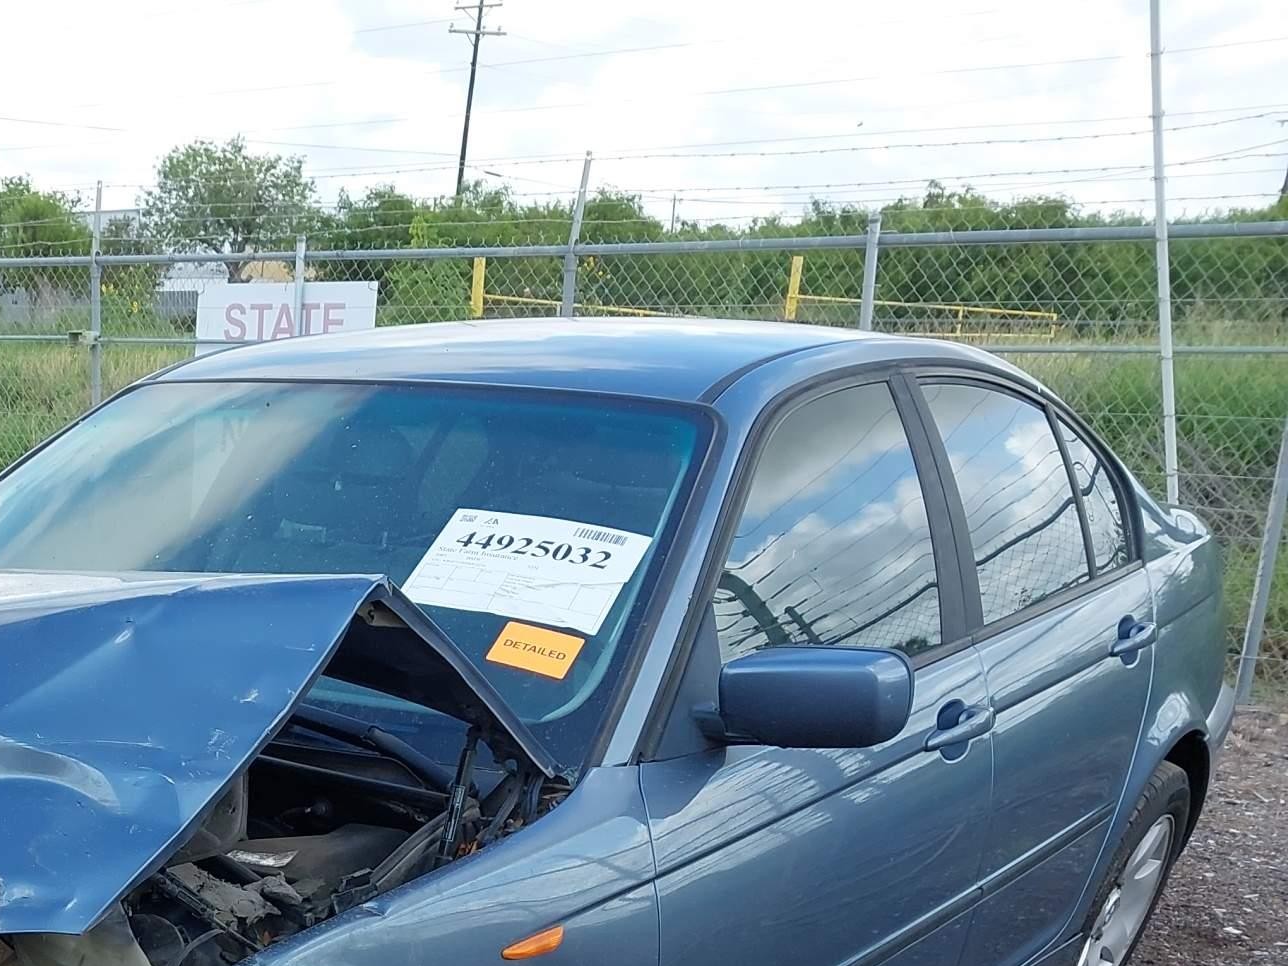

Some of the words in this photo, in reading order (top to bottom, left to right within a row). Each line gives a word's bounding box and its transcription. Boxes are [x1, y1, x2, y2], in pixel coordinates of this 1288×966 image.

[223, 303, 347, 341] STATE
[456, 531, 612, 569] 44925032
[503, 638, 567, 661] DETAILED
